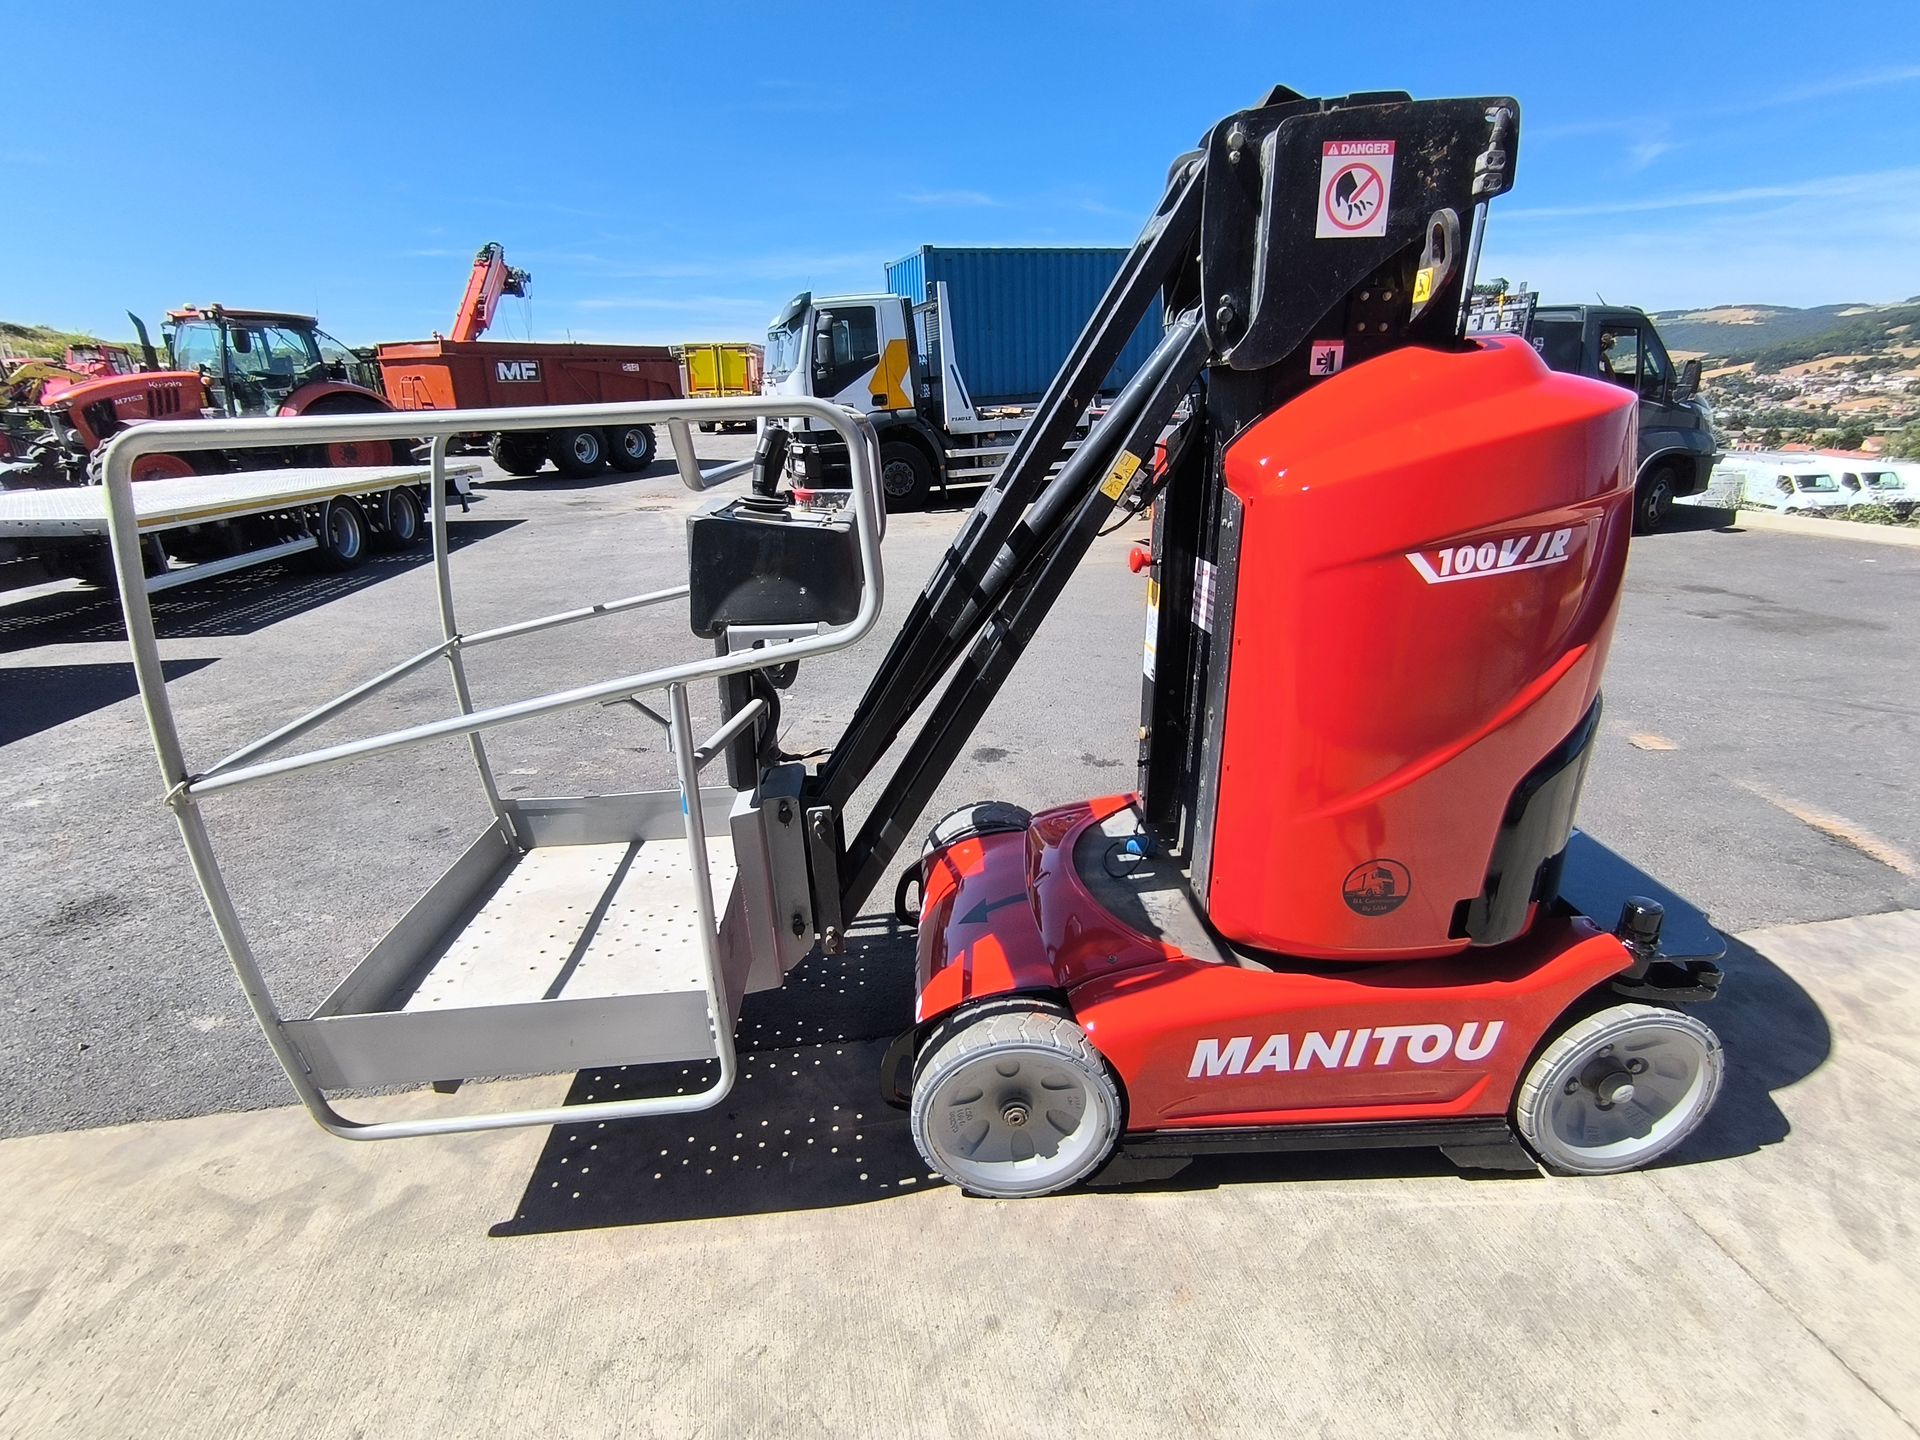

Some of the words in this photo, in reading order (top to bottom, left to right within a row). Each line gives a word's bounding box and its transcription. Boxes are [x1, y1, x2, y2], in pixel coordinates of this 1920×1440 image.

[1341, 143, 1389, 155] DANGER
[497, 362, 537, 380] MF
[1187, 1021, 1504, 1078] MANITOU
